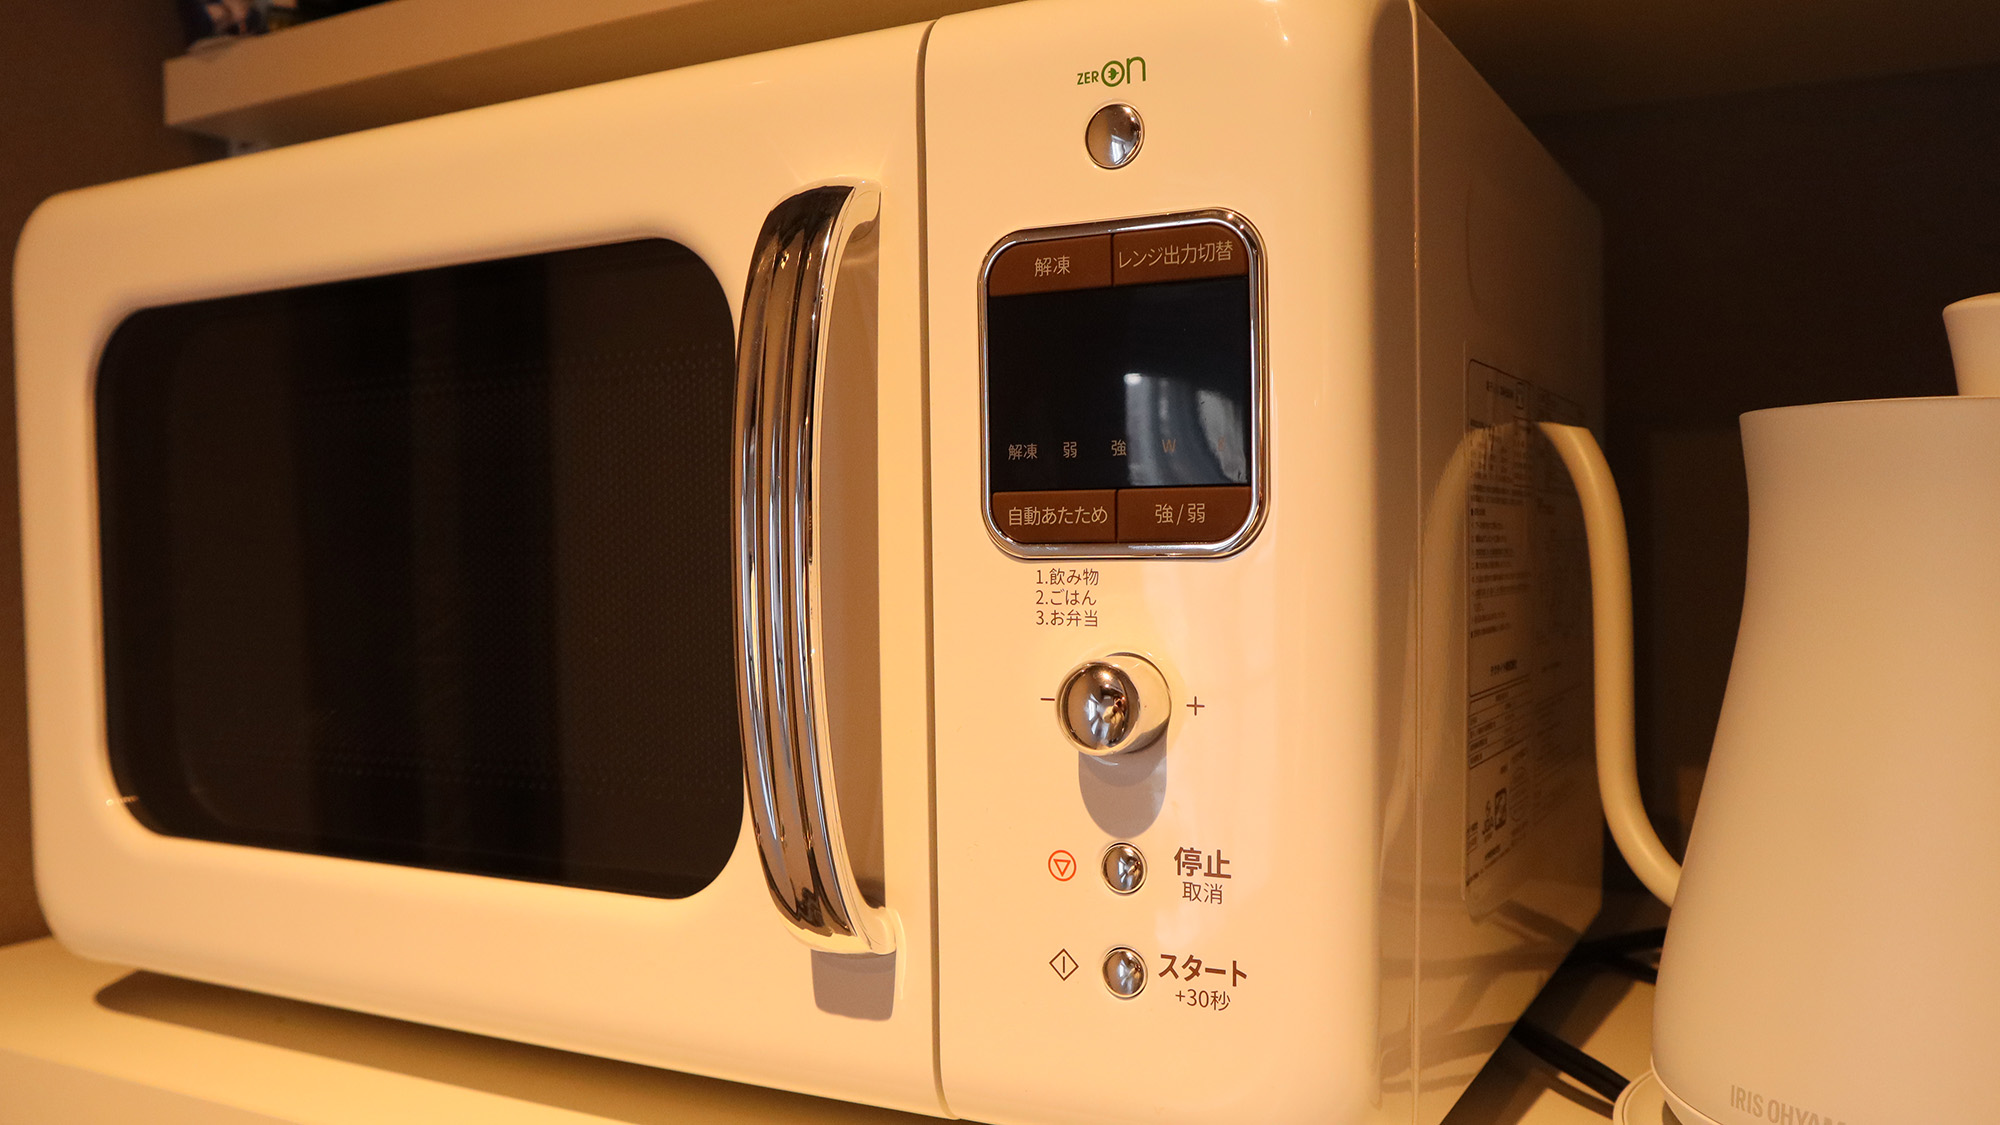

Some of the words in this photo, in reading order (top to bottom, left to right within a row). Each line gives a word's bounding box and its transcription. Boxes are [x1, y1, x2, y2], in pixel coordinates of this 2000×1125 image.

[1034, 254, 1071, 278] 解凍
[1118, 240, 1234, 269] レンジ出力切替
[1008, 443, 1038, 461] 解凍
[1063, 441, 1078, 459] 弱
[1111, 439, 1127, 457] 強
[1008, 505, 1108, 527] 自動あたため
[1035, 567, 1100, 587] 1.飲み物
[1035, 588, 1097, 607] 2.ごはん
[1035, 609, 1099, 627] 3.お弁当
[1173, 846, 1232, 879] 停止
[1181, 881, 1223, 905] 取消
[1158, 953, 1248, 988] スタート
[1175, 988, 1231, 1012] +30秒
[1730, 1084, 1763, 1118] IRIS
